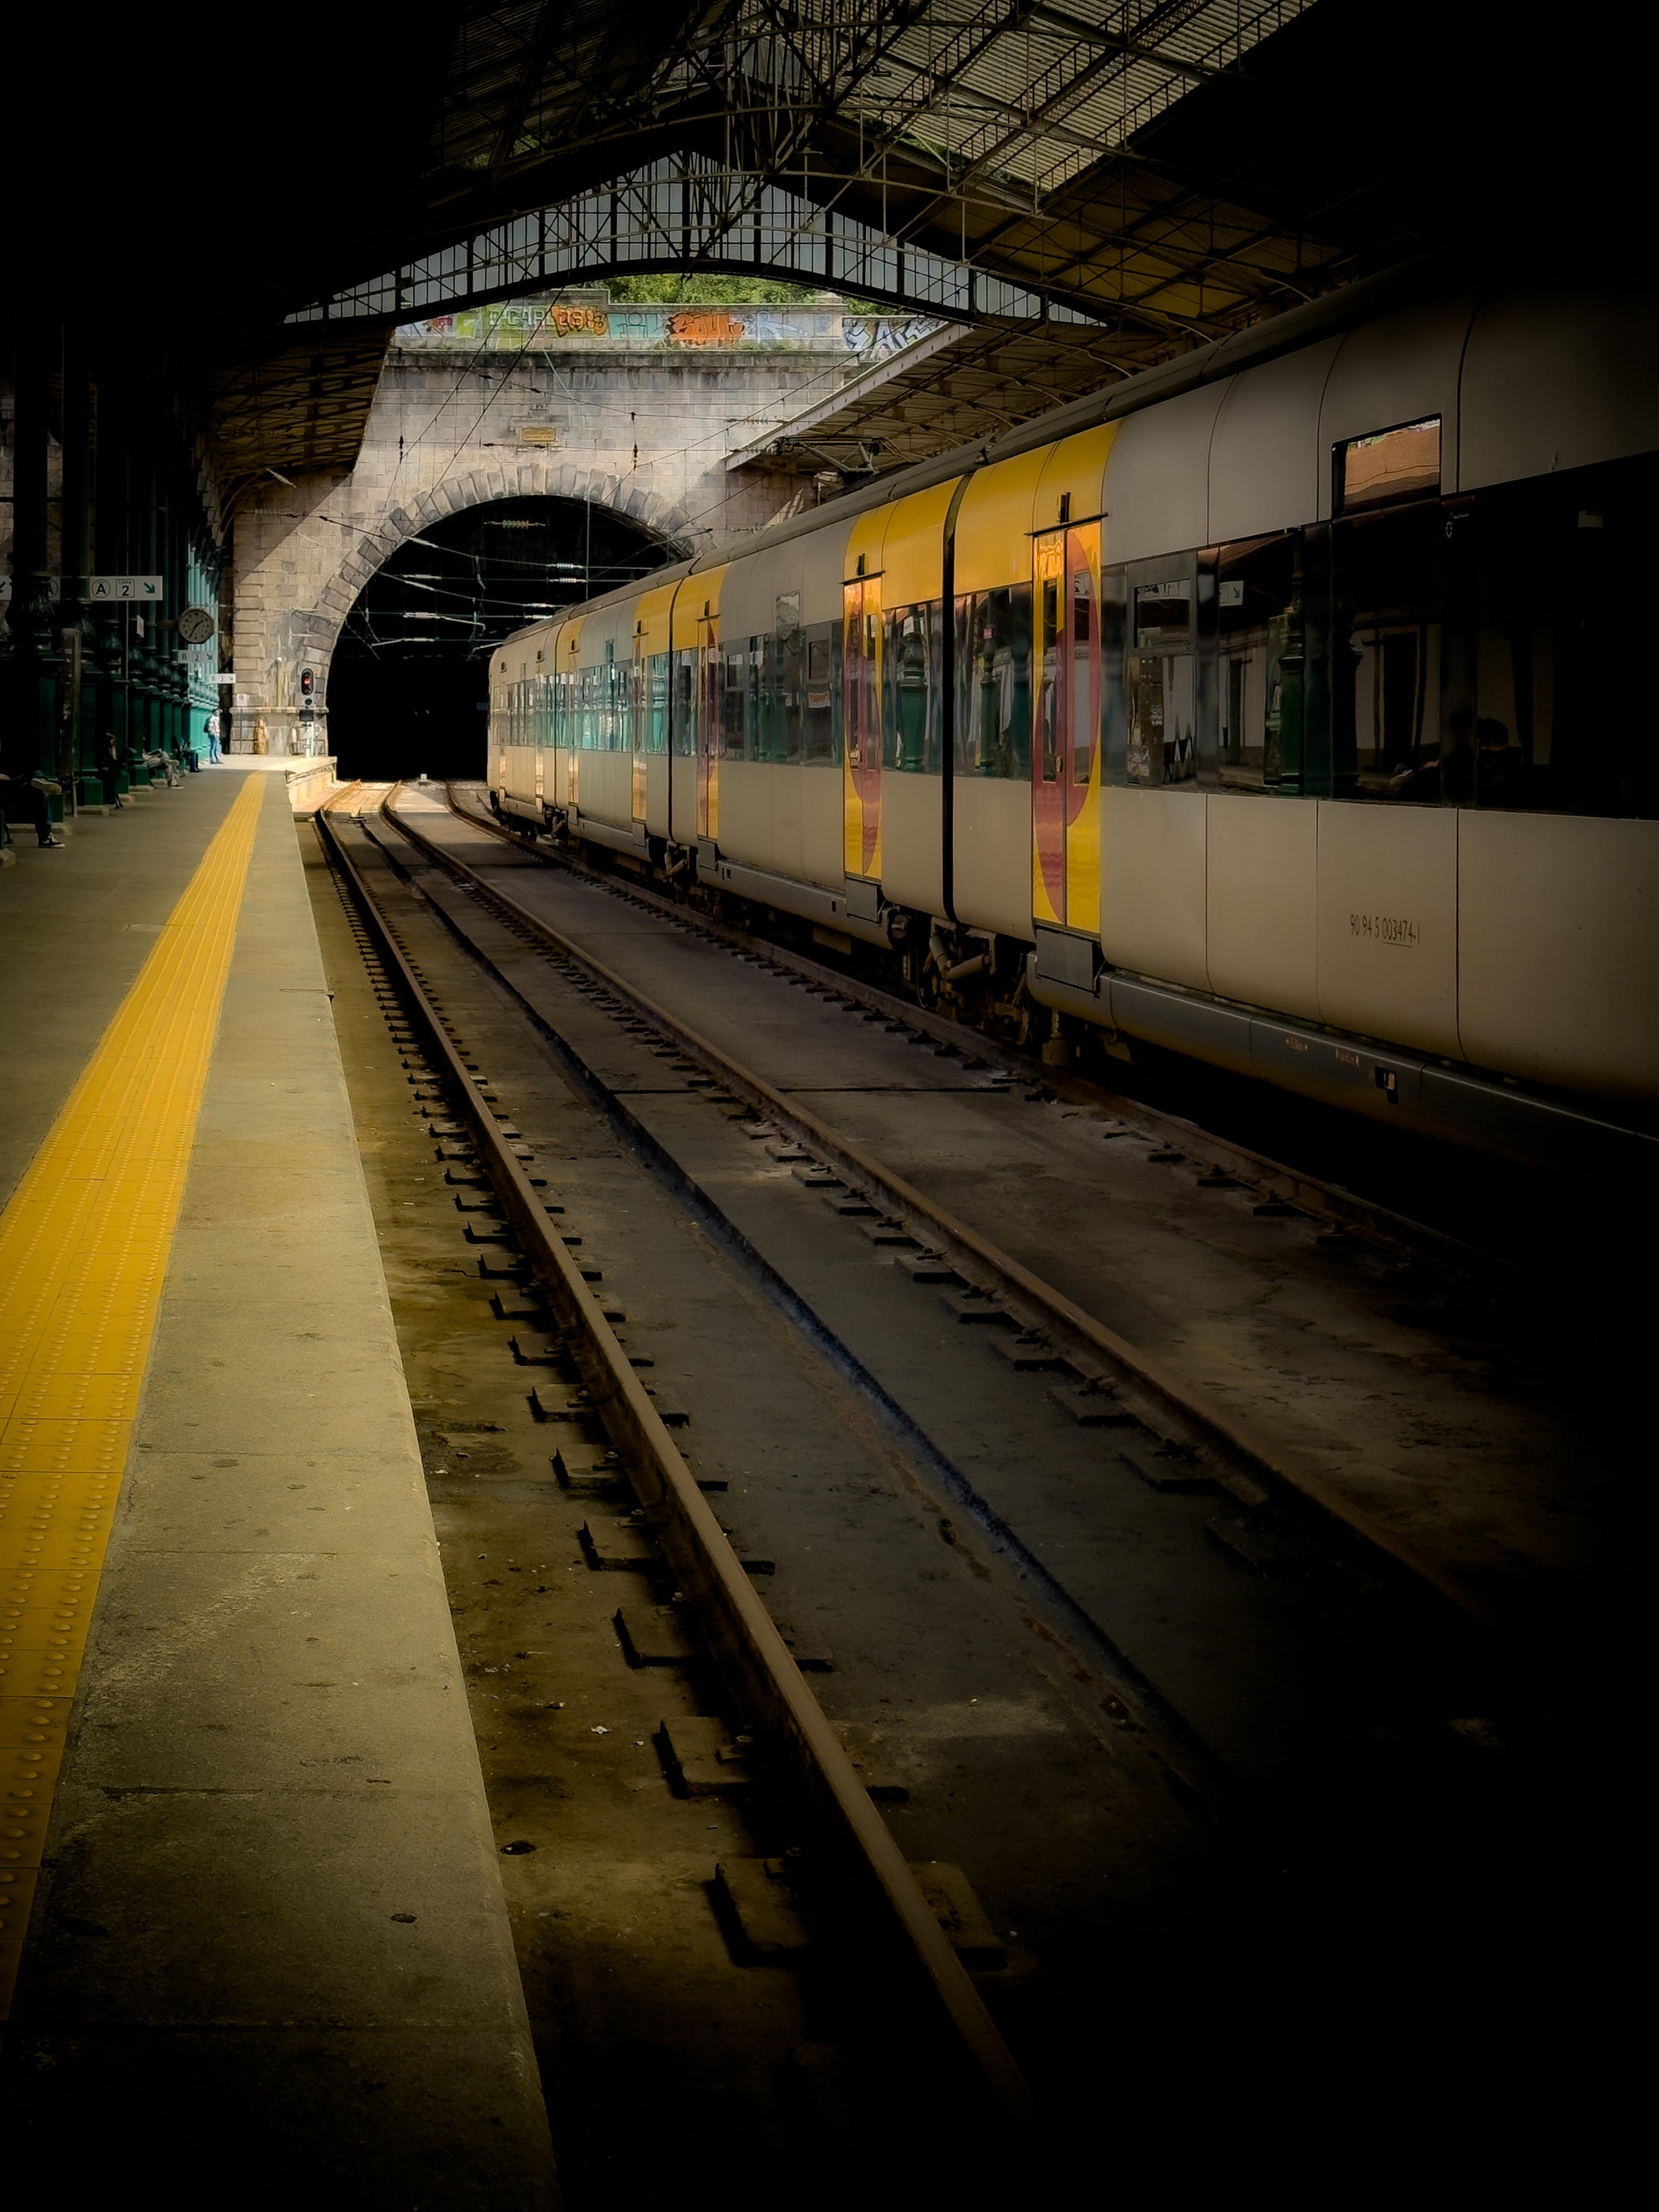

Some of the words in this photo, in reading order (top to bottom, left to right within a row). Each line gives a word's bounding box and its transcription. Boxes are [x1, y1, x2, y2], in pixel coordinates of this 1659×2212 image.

[95, 583, 106, 595] A
[122, 585, 129, 596] 2
[1350, 914, 1360, 936] 90
[1362, 915, 1372, 937] 94
[1374, 916, 1379, 939] 5
